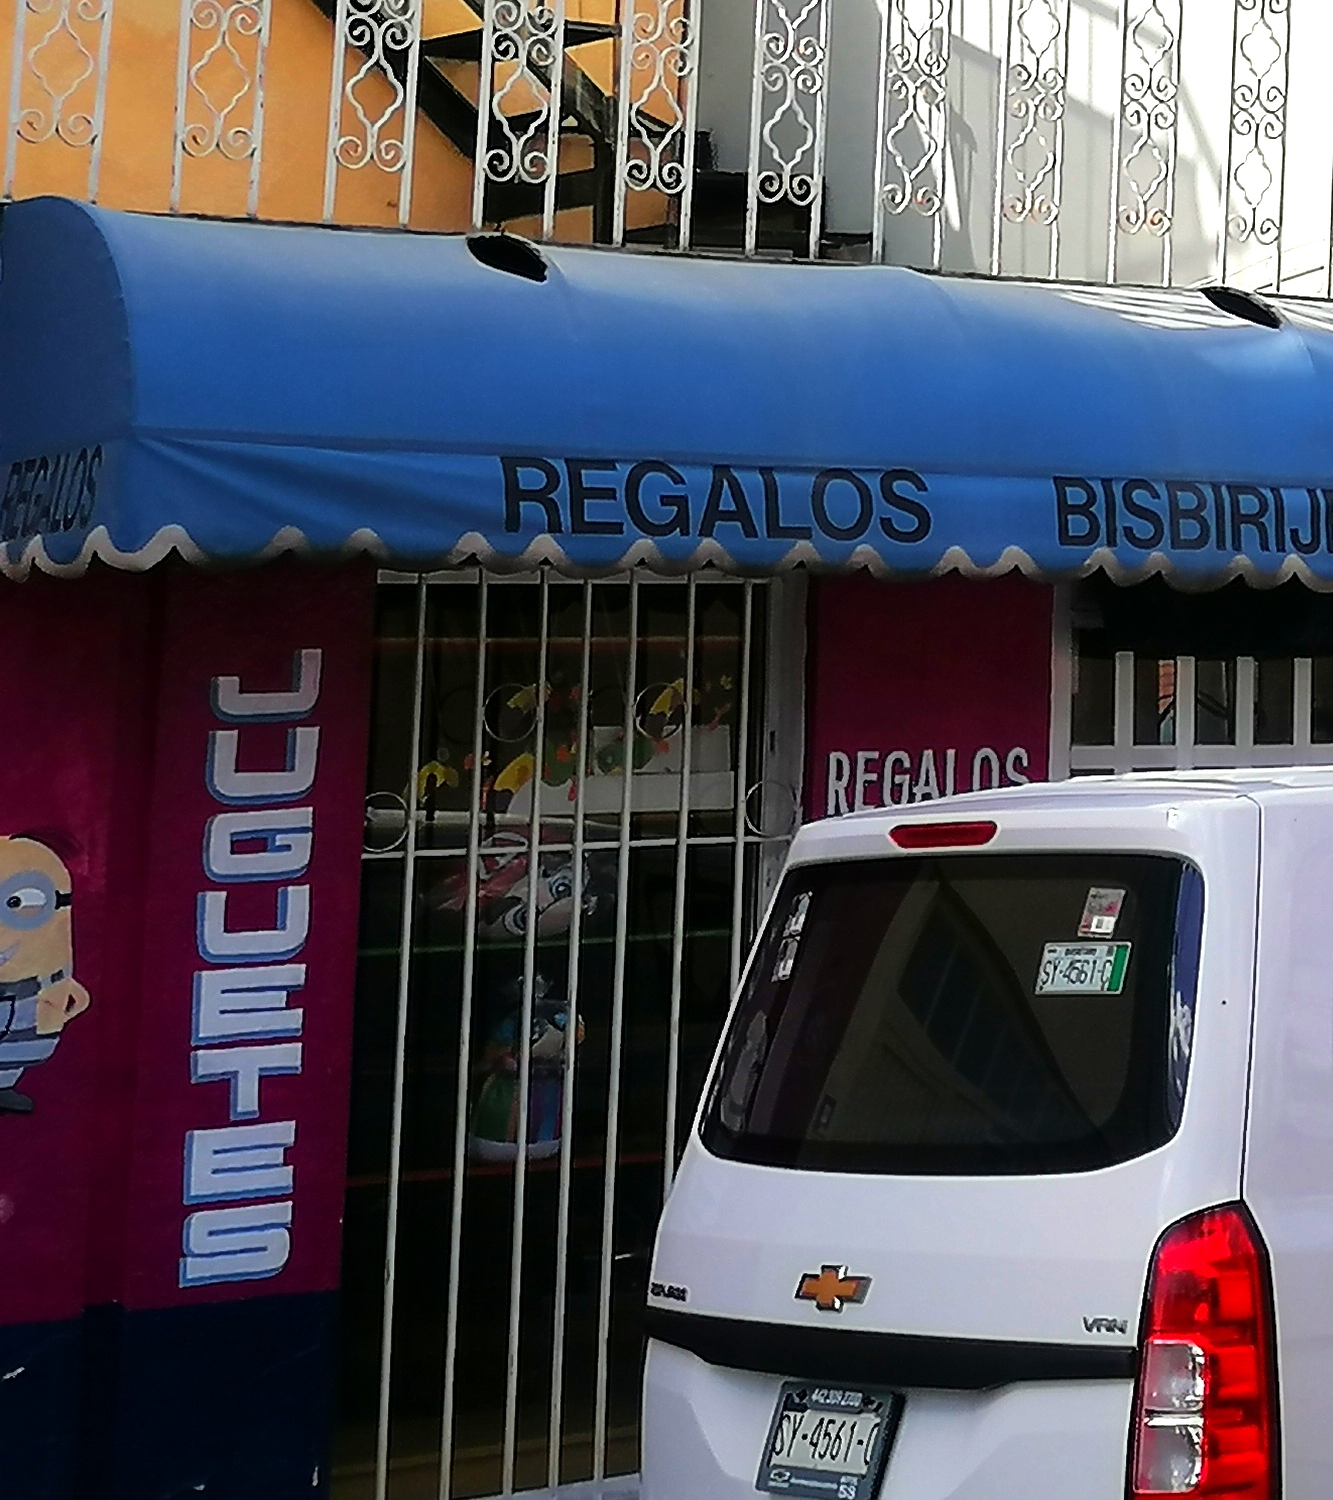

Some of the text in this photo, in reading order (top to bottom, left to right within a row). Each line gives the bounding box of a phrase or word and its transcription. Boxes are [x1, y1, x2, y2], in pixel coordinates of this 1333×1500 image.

[496, 455, 933, 545] REGALOS
[827, 746, 1030, 816] REGALOS
[179, 648, 323, 1288] JUGUETES
